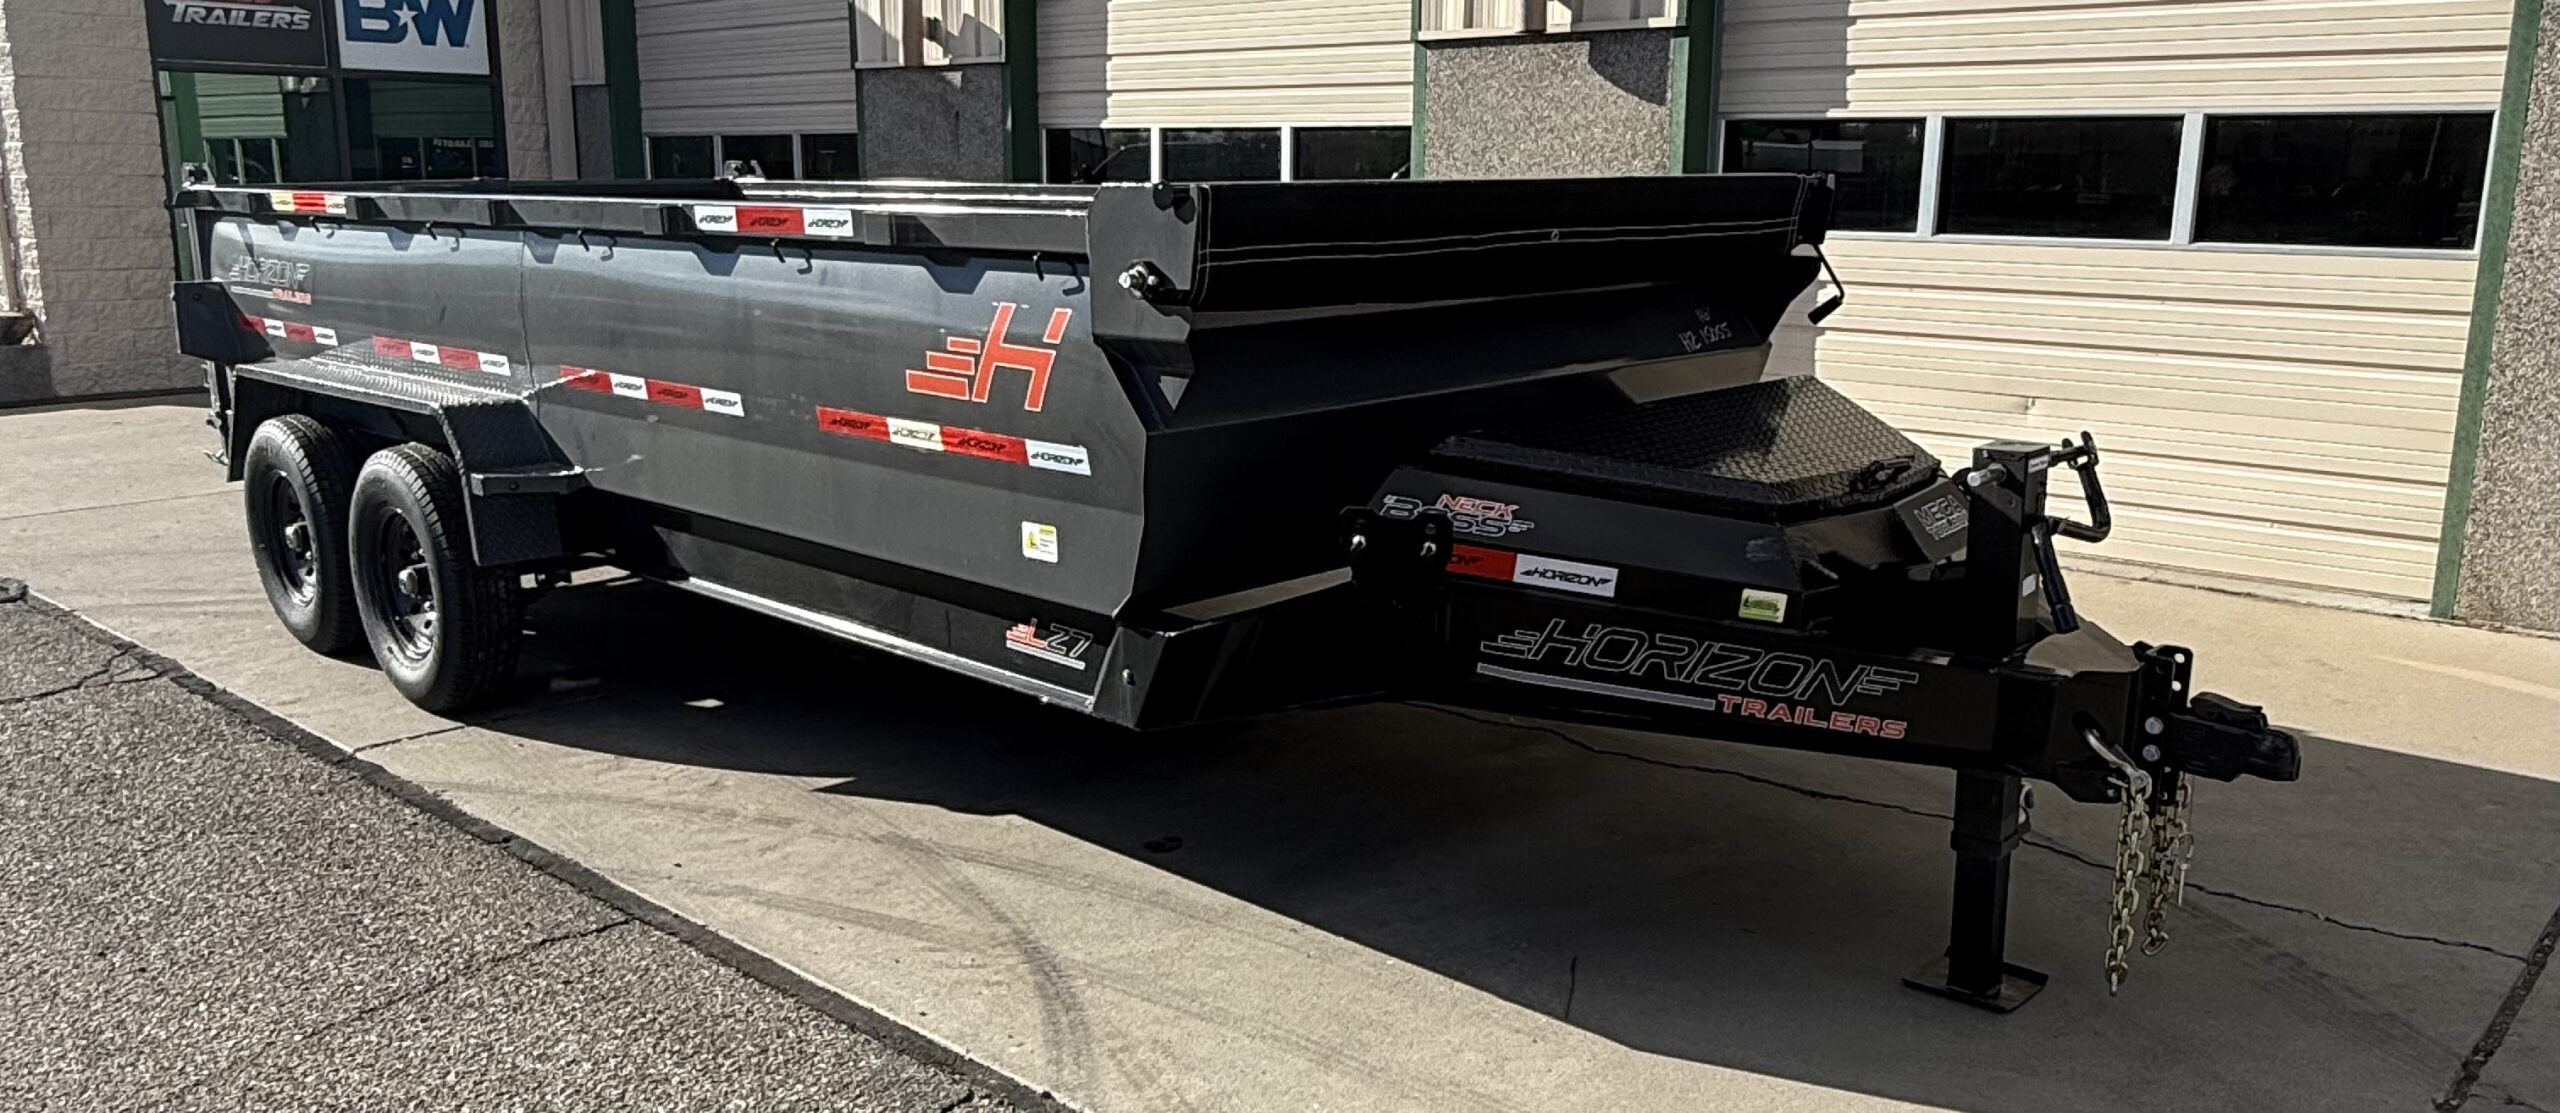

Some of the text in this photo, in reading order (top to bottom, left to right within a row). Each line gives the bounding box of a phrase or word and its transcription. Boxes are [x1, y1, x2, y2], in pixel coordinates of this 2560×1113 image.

[165, 1, 312, 31] TRAILERS
[1434, 493, 1519, 521] NECK
[1527, 566, 1606, 588] HORIZON
[1526, 618, 1874, 706] HORIZON
[1718, 694, 1908, 739] TRAILERS
